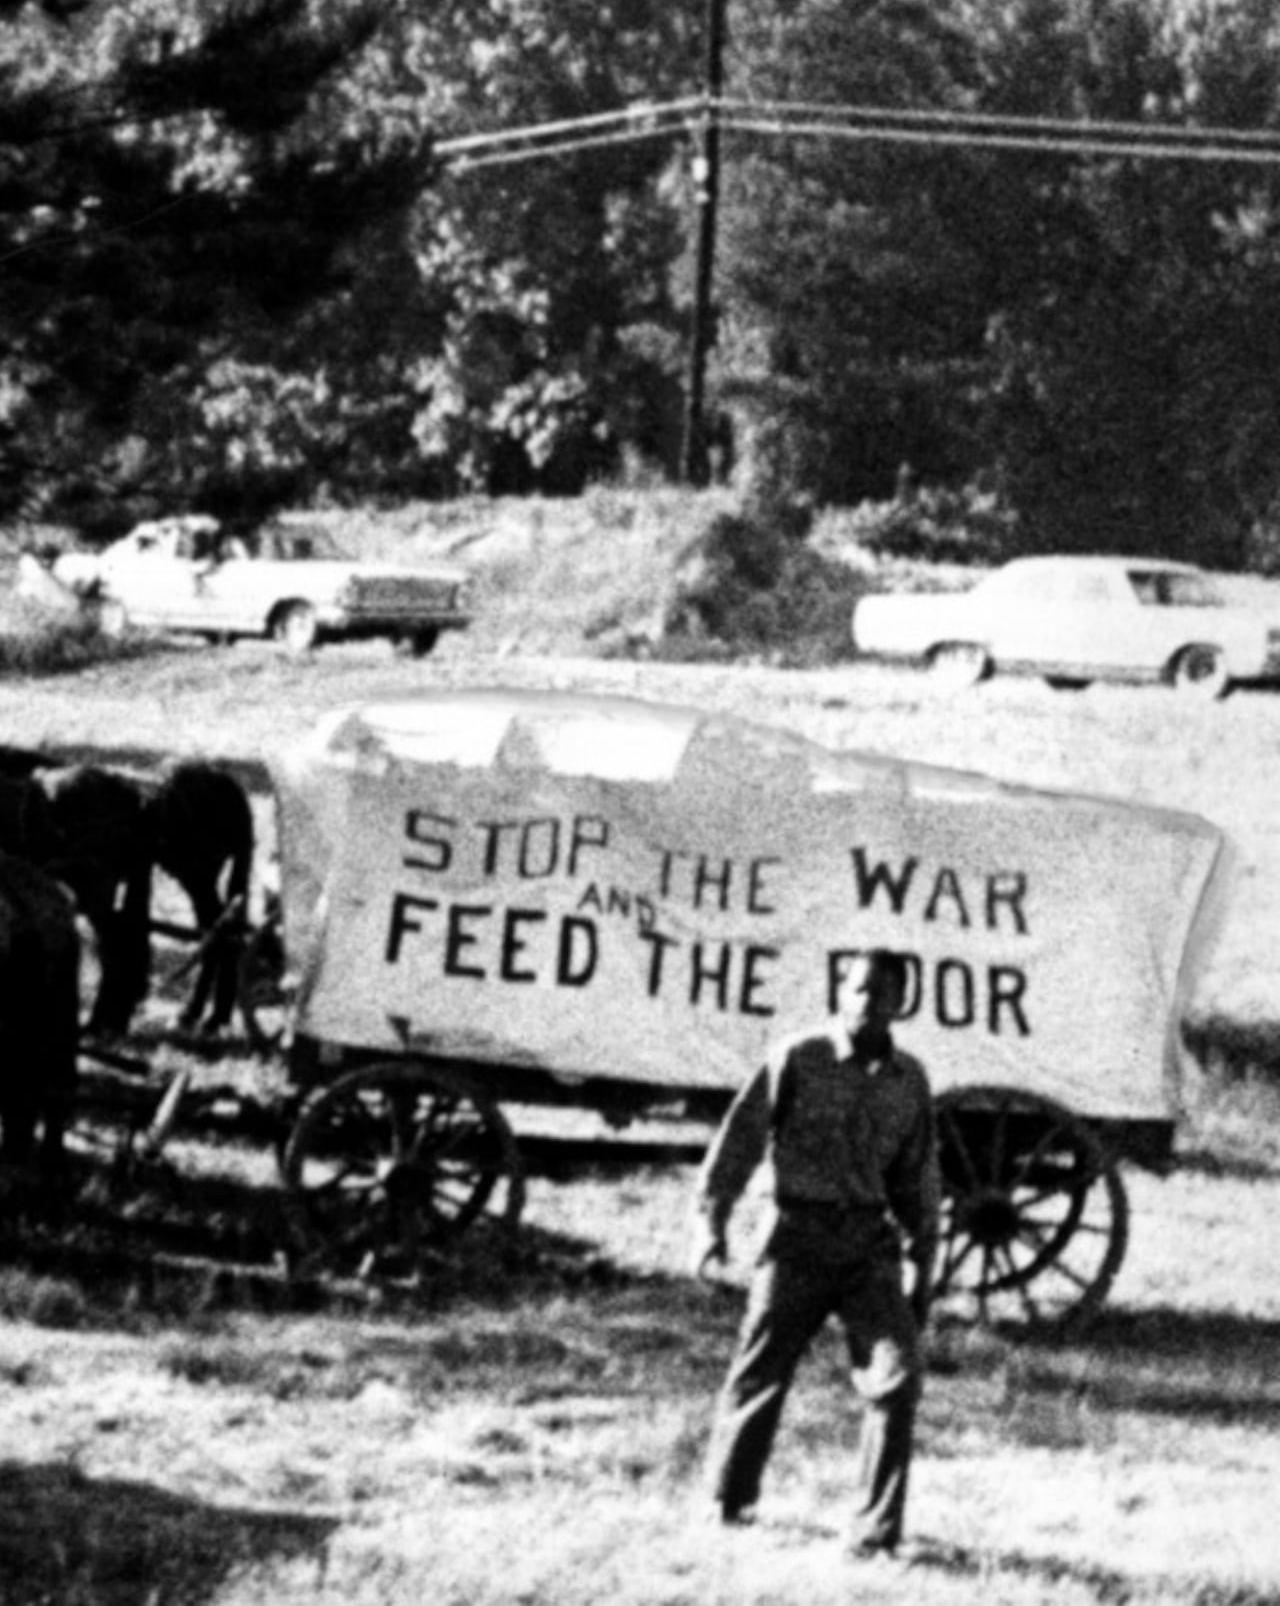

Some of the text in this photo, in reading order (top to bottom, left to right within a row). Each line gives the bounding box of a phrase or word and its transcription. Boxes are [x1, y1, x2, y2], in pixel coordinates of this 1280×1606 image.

[402, 808, 1029, 937] STOP THE WAR
[575, 882, 657, 934] AND
[384, 891, 600, 987] FEED
[637, 929, 782, 1018] THE
